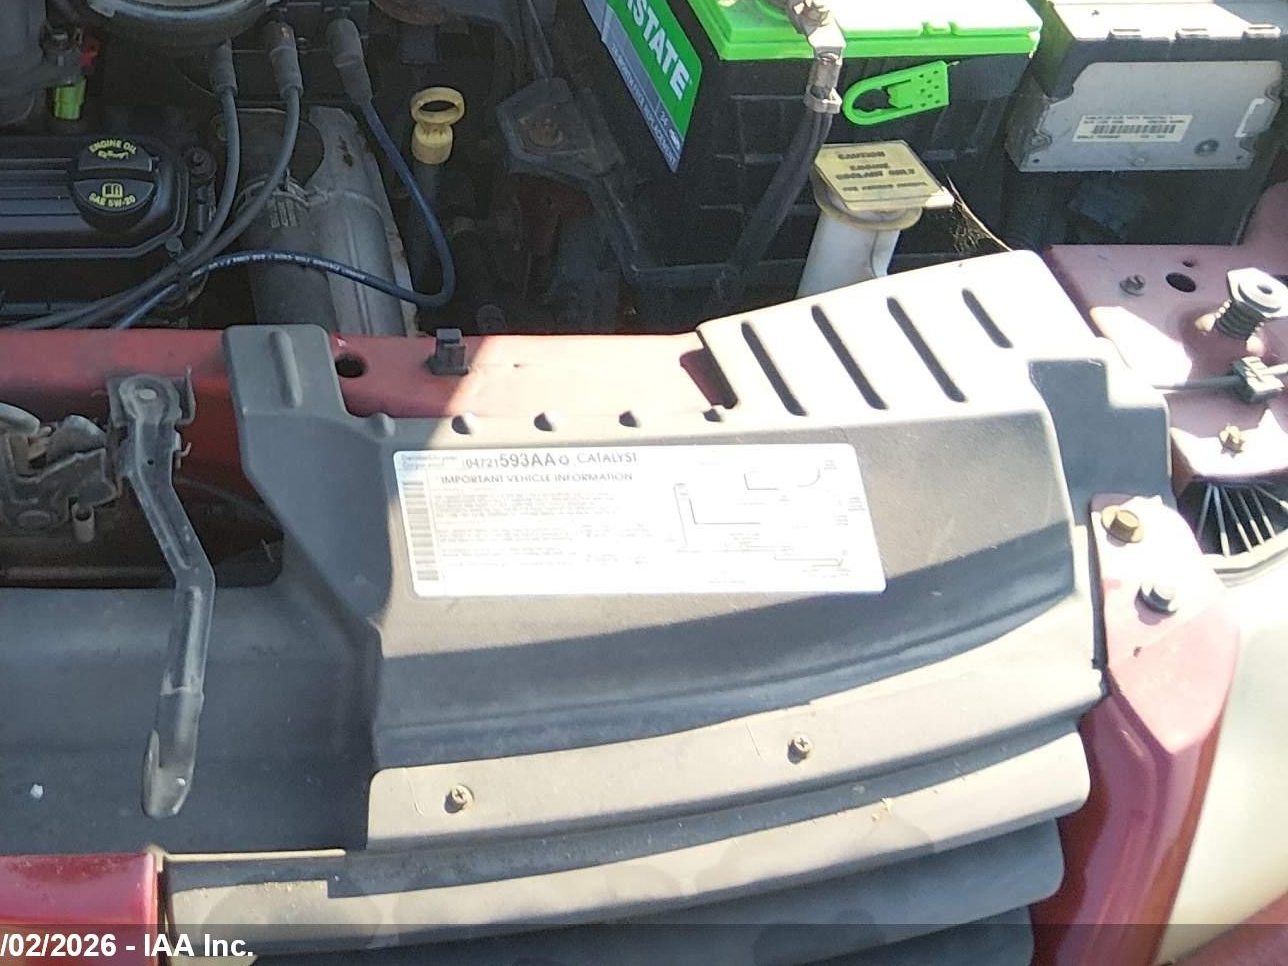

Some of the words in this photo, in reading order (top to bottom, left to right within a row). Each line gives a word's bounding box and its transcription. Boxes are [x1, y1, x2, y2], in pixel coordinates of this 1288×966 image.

[88, 139, 122, 153] ENGINE
[123, 141, 137, 155] OIL
[88, 192, 107, 206] SAE
[576, 452, 638, 465] CATALYST
[441, 475, 504, 485] IMPORTANT
[507, 474, 551, 483] VEHICLE
[554, 473, 634, 483] INFORMATION
